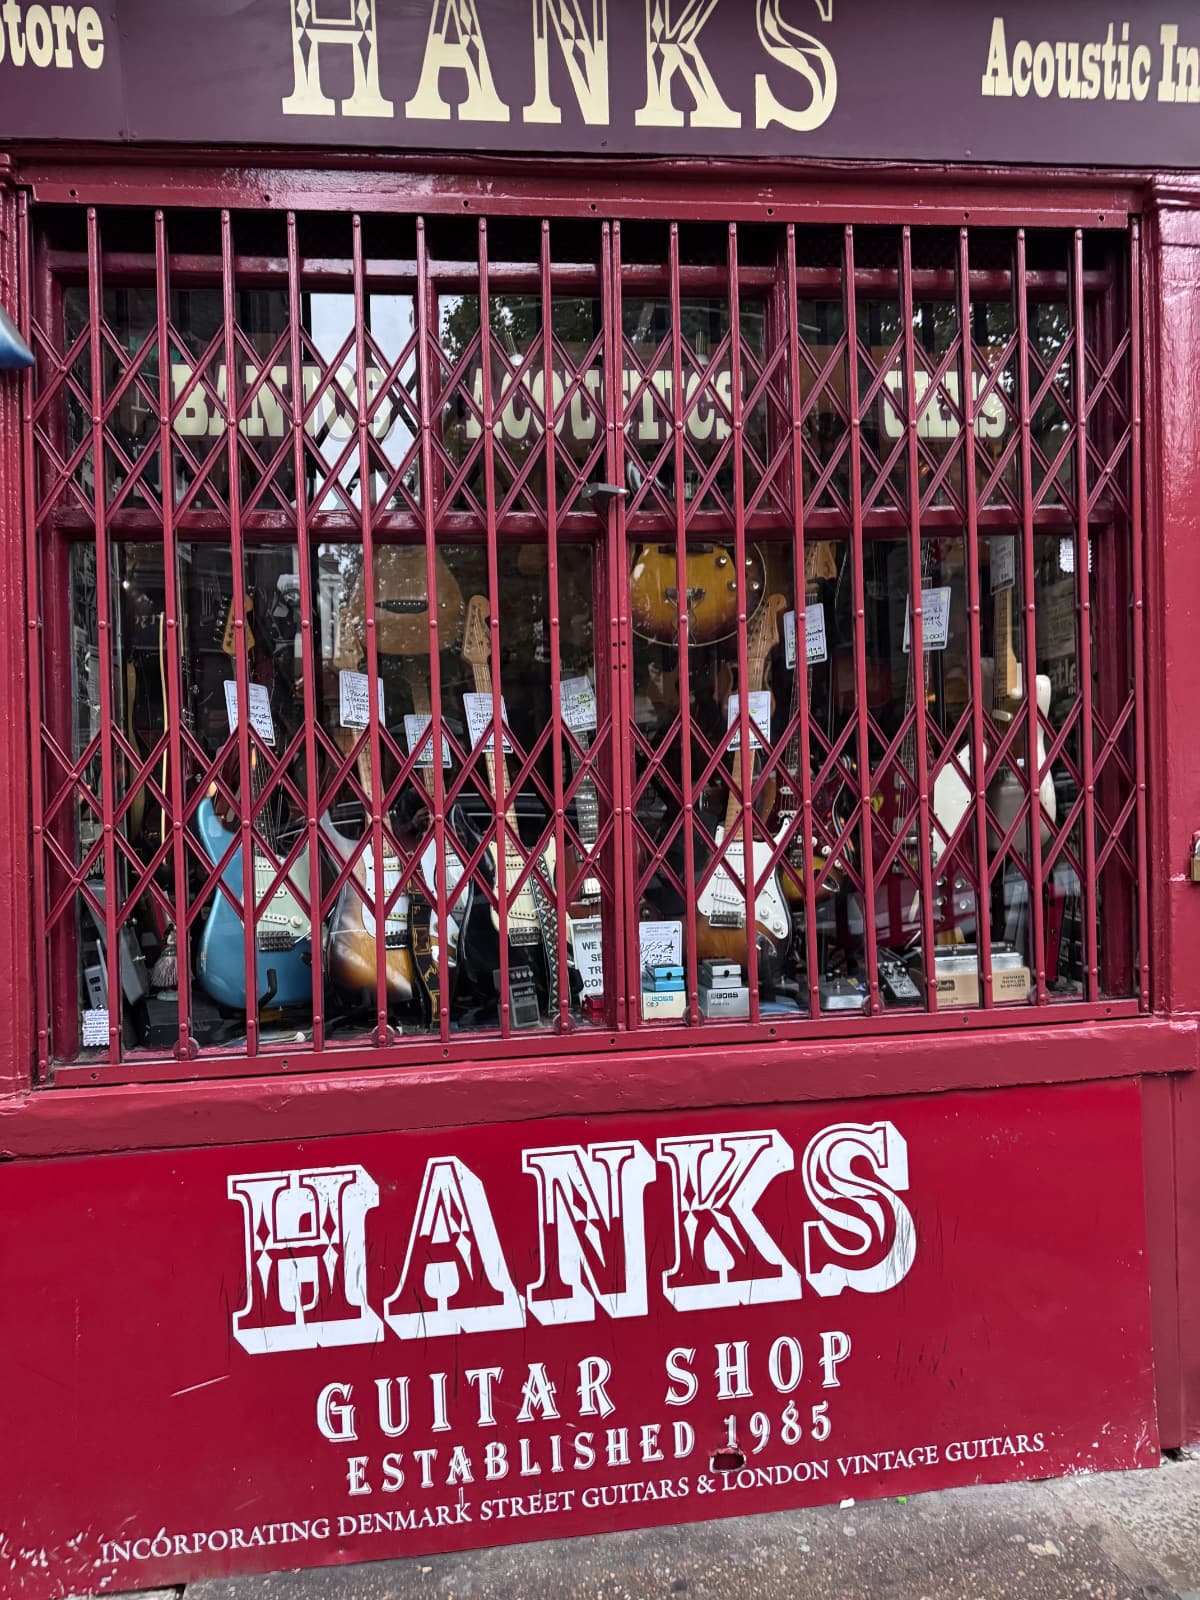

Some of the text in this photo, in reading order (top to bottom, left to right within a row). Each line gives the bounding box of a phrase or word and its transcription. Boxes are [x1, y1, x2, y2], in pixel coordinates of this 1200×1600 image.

[0, 0, 104, 69] tore
[282, 0, 837, 131] HANKS
[982, 17, 1151, 101] Acoustic
[227, 1121, 916, 1354] HANKS
[317, 1331, 851, 1442] GUITAR SHOP
[101, 1433, 1044, 1564] INCORPORATING DENMARK STREET GUITARS & LONDON VINTAGE GUITARS
[347, 1400, 832, 1496] ESTABLISHED 1985
